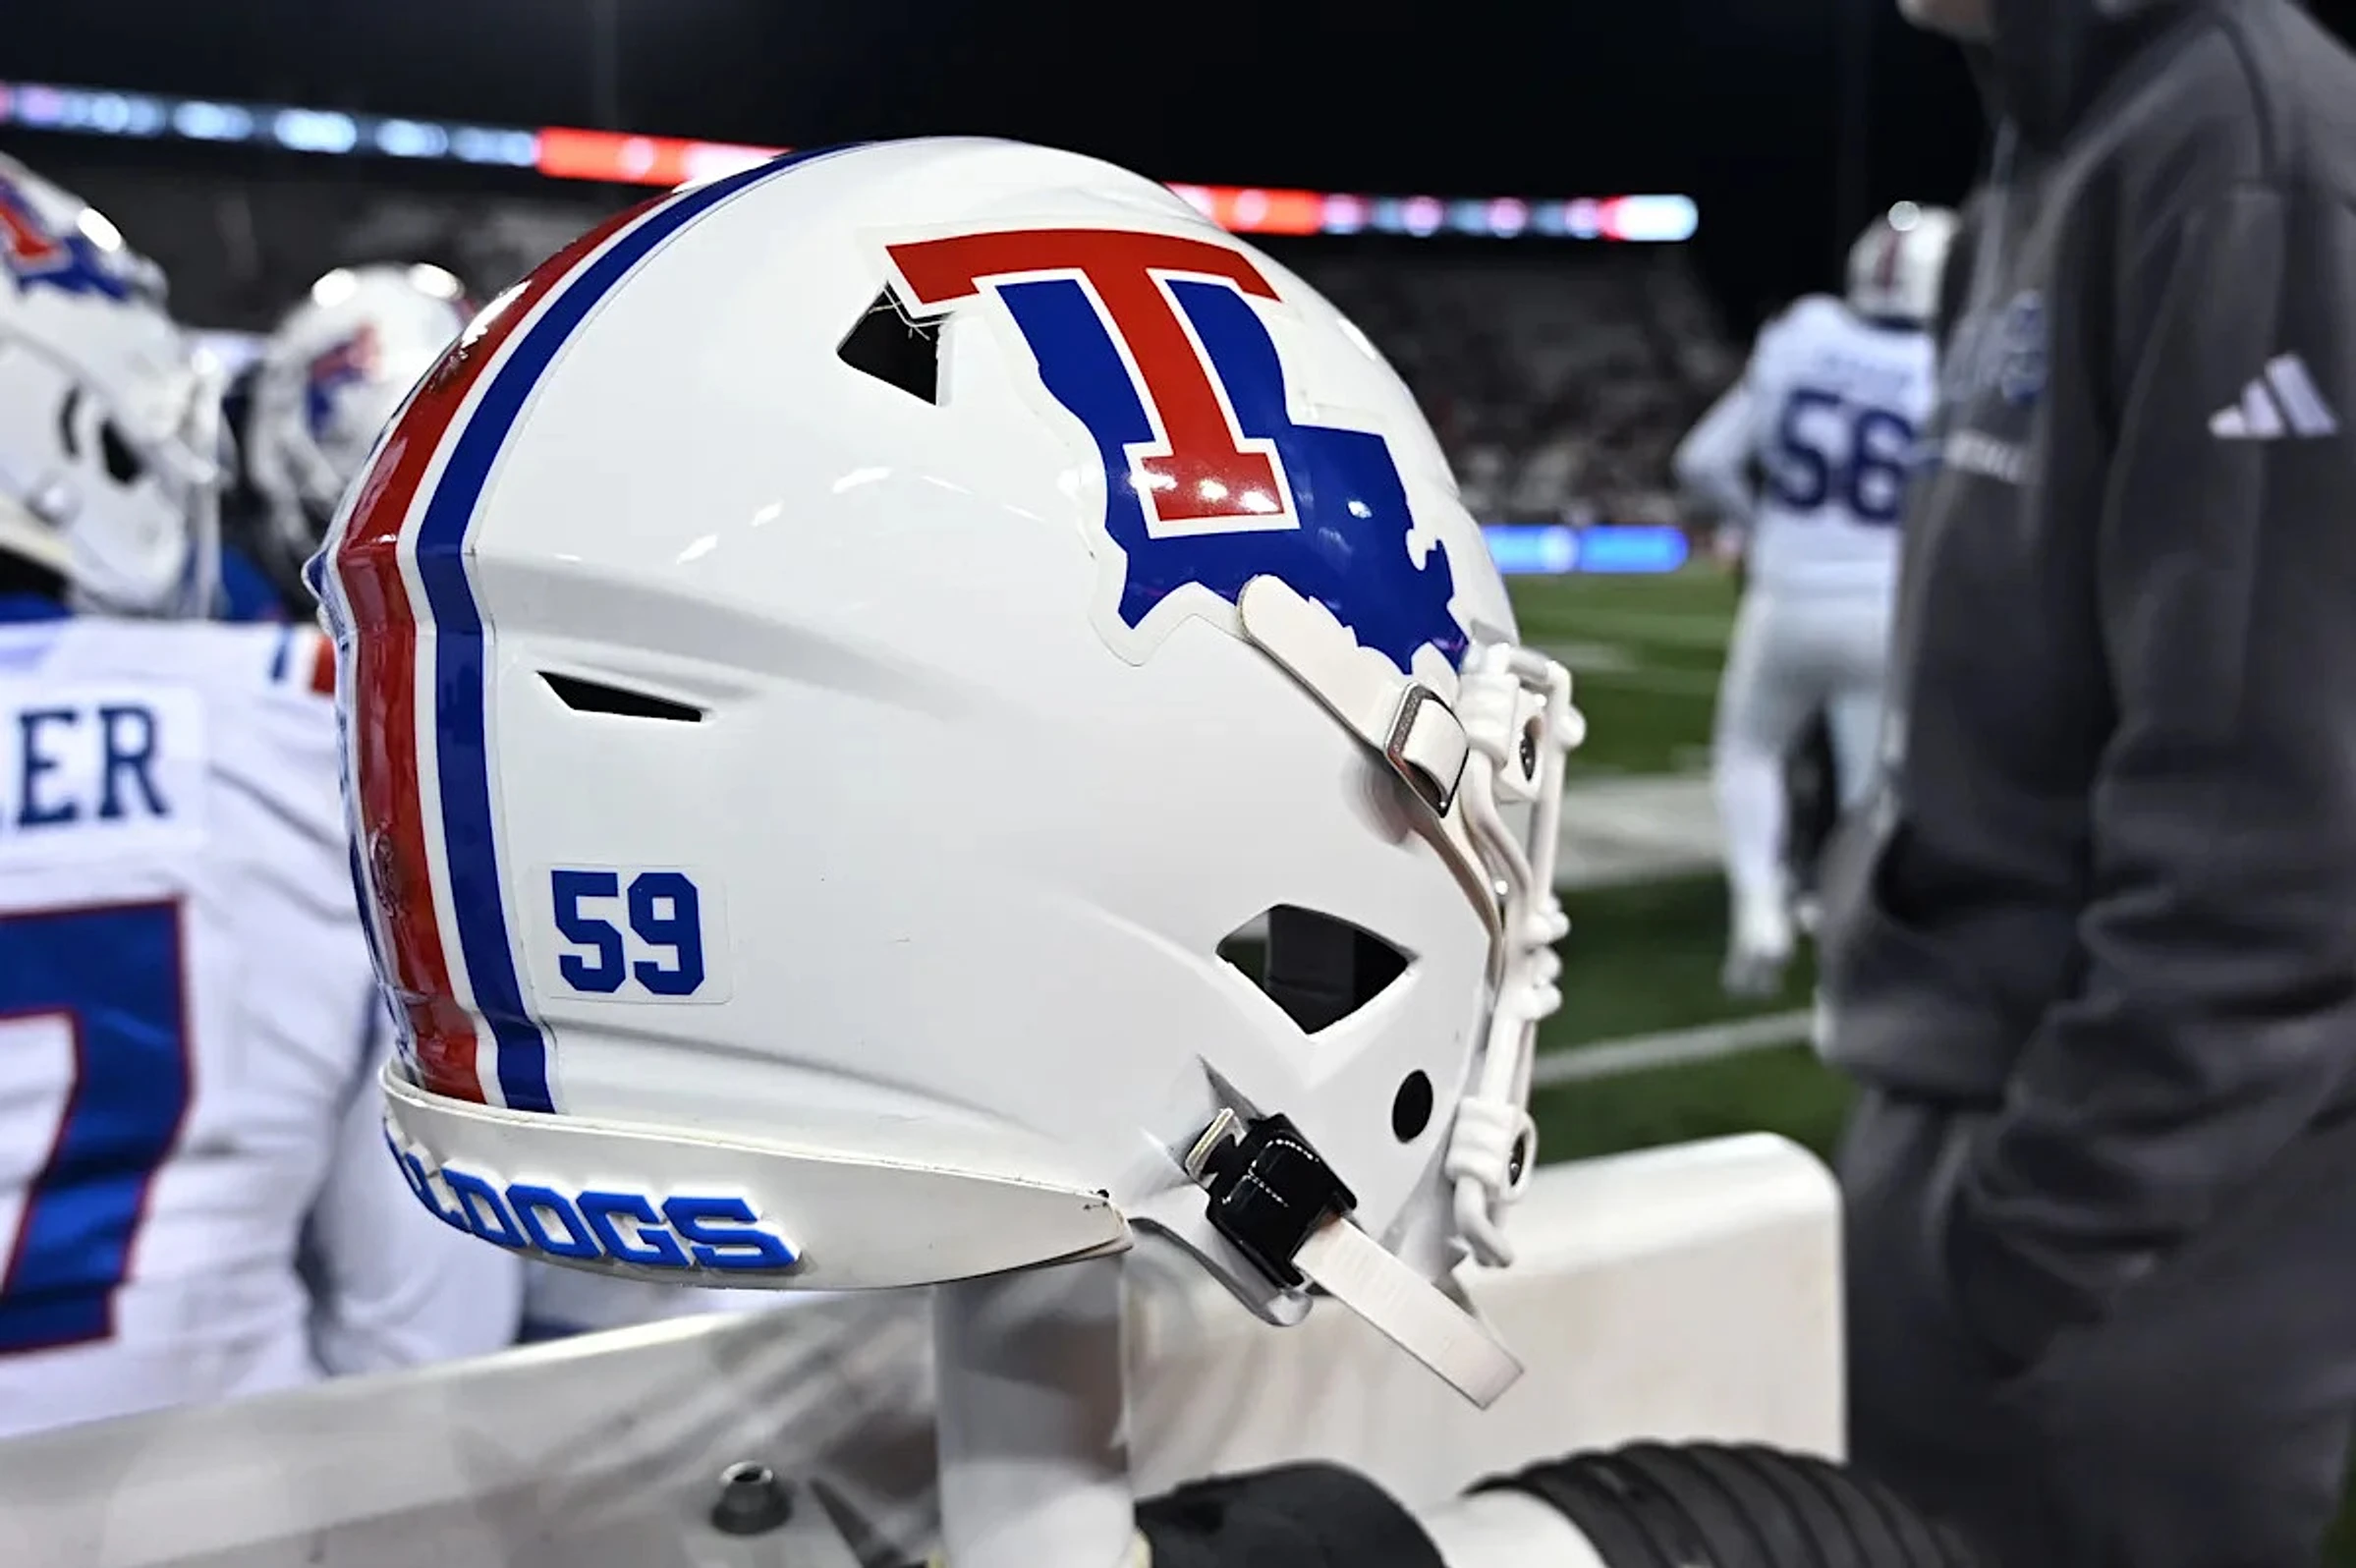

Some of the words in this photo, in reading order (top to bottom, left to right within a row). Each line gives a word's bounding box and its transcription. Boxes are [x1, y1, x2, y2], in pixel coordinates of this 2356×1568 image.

[885, 228, 1284, 522] T
[1770, 387, 1917, 523] 56
[0, 703, 171, 827] ER
[550, 869, 704, 996] 59
[0, 896, 195, 1354] 7
[384, 1118, 803, 1269] LDOGS
